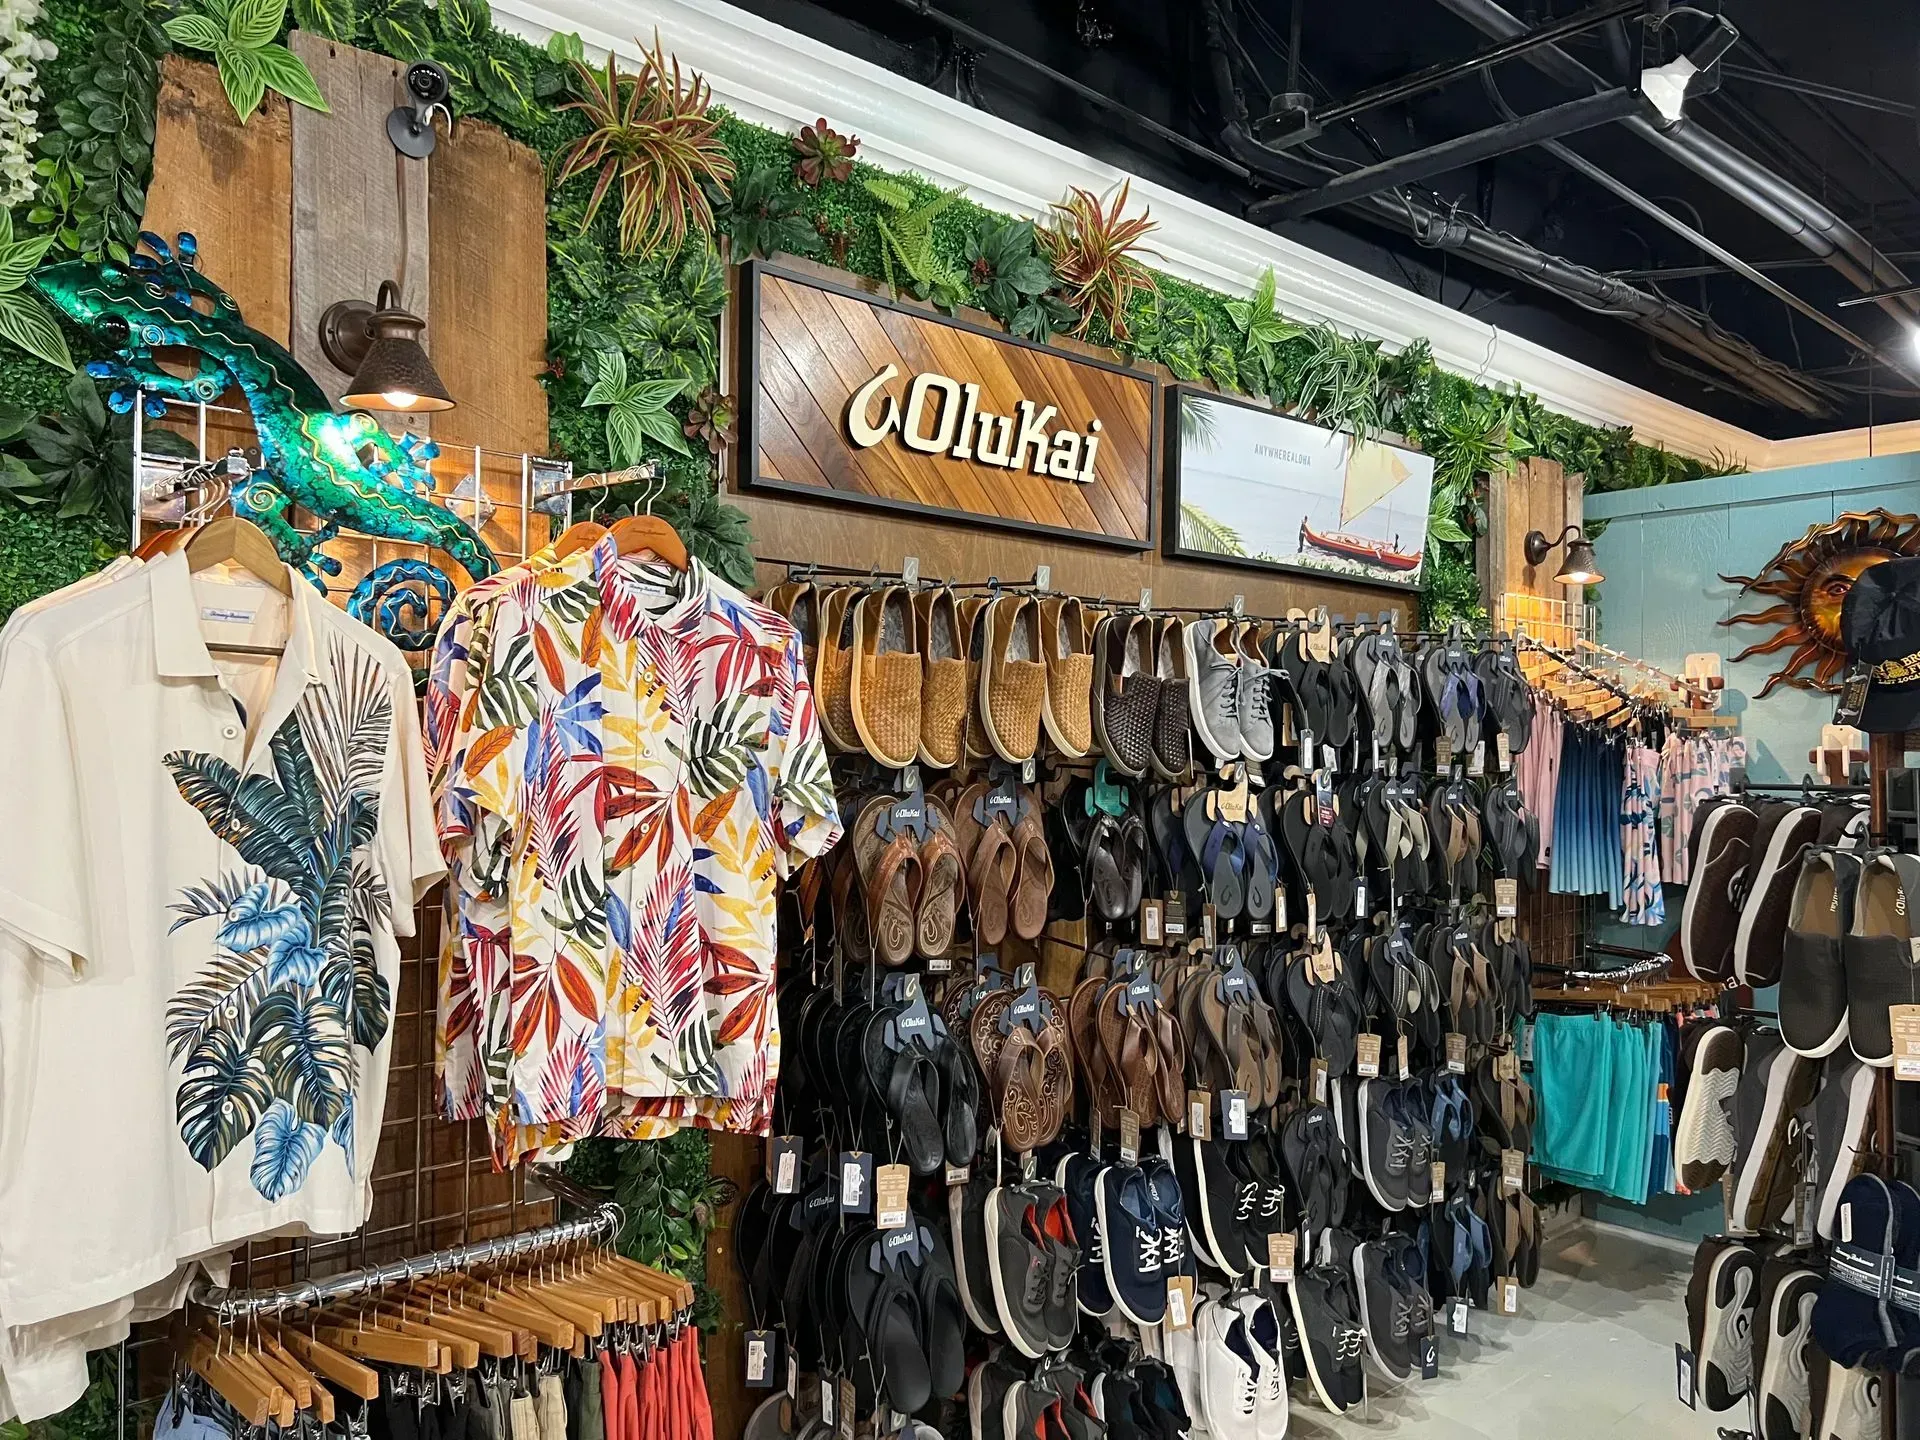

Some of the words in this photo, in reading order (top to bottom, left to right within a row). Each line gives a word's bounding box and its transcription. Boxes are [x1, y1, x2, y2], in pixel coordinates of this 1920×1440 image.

[903, 372, 1102, 483] OluKai
[1254, 443, 1311, 466] ANYWHEREALOHA
[1896, 886, 1905, 909] OluK
